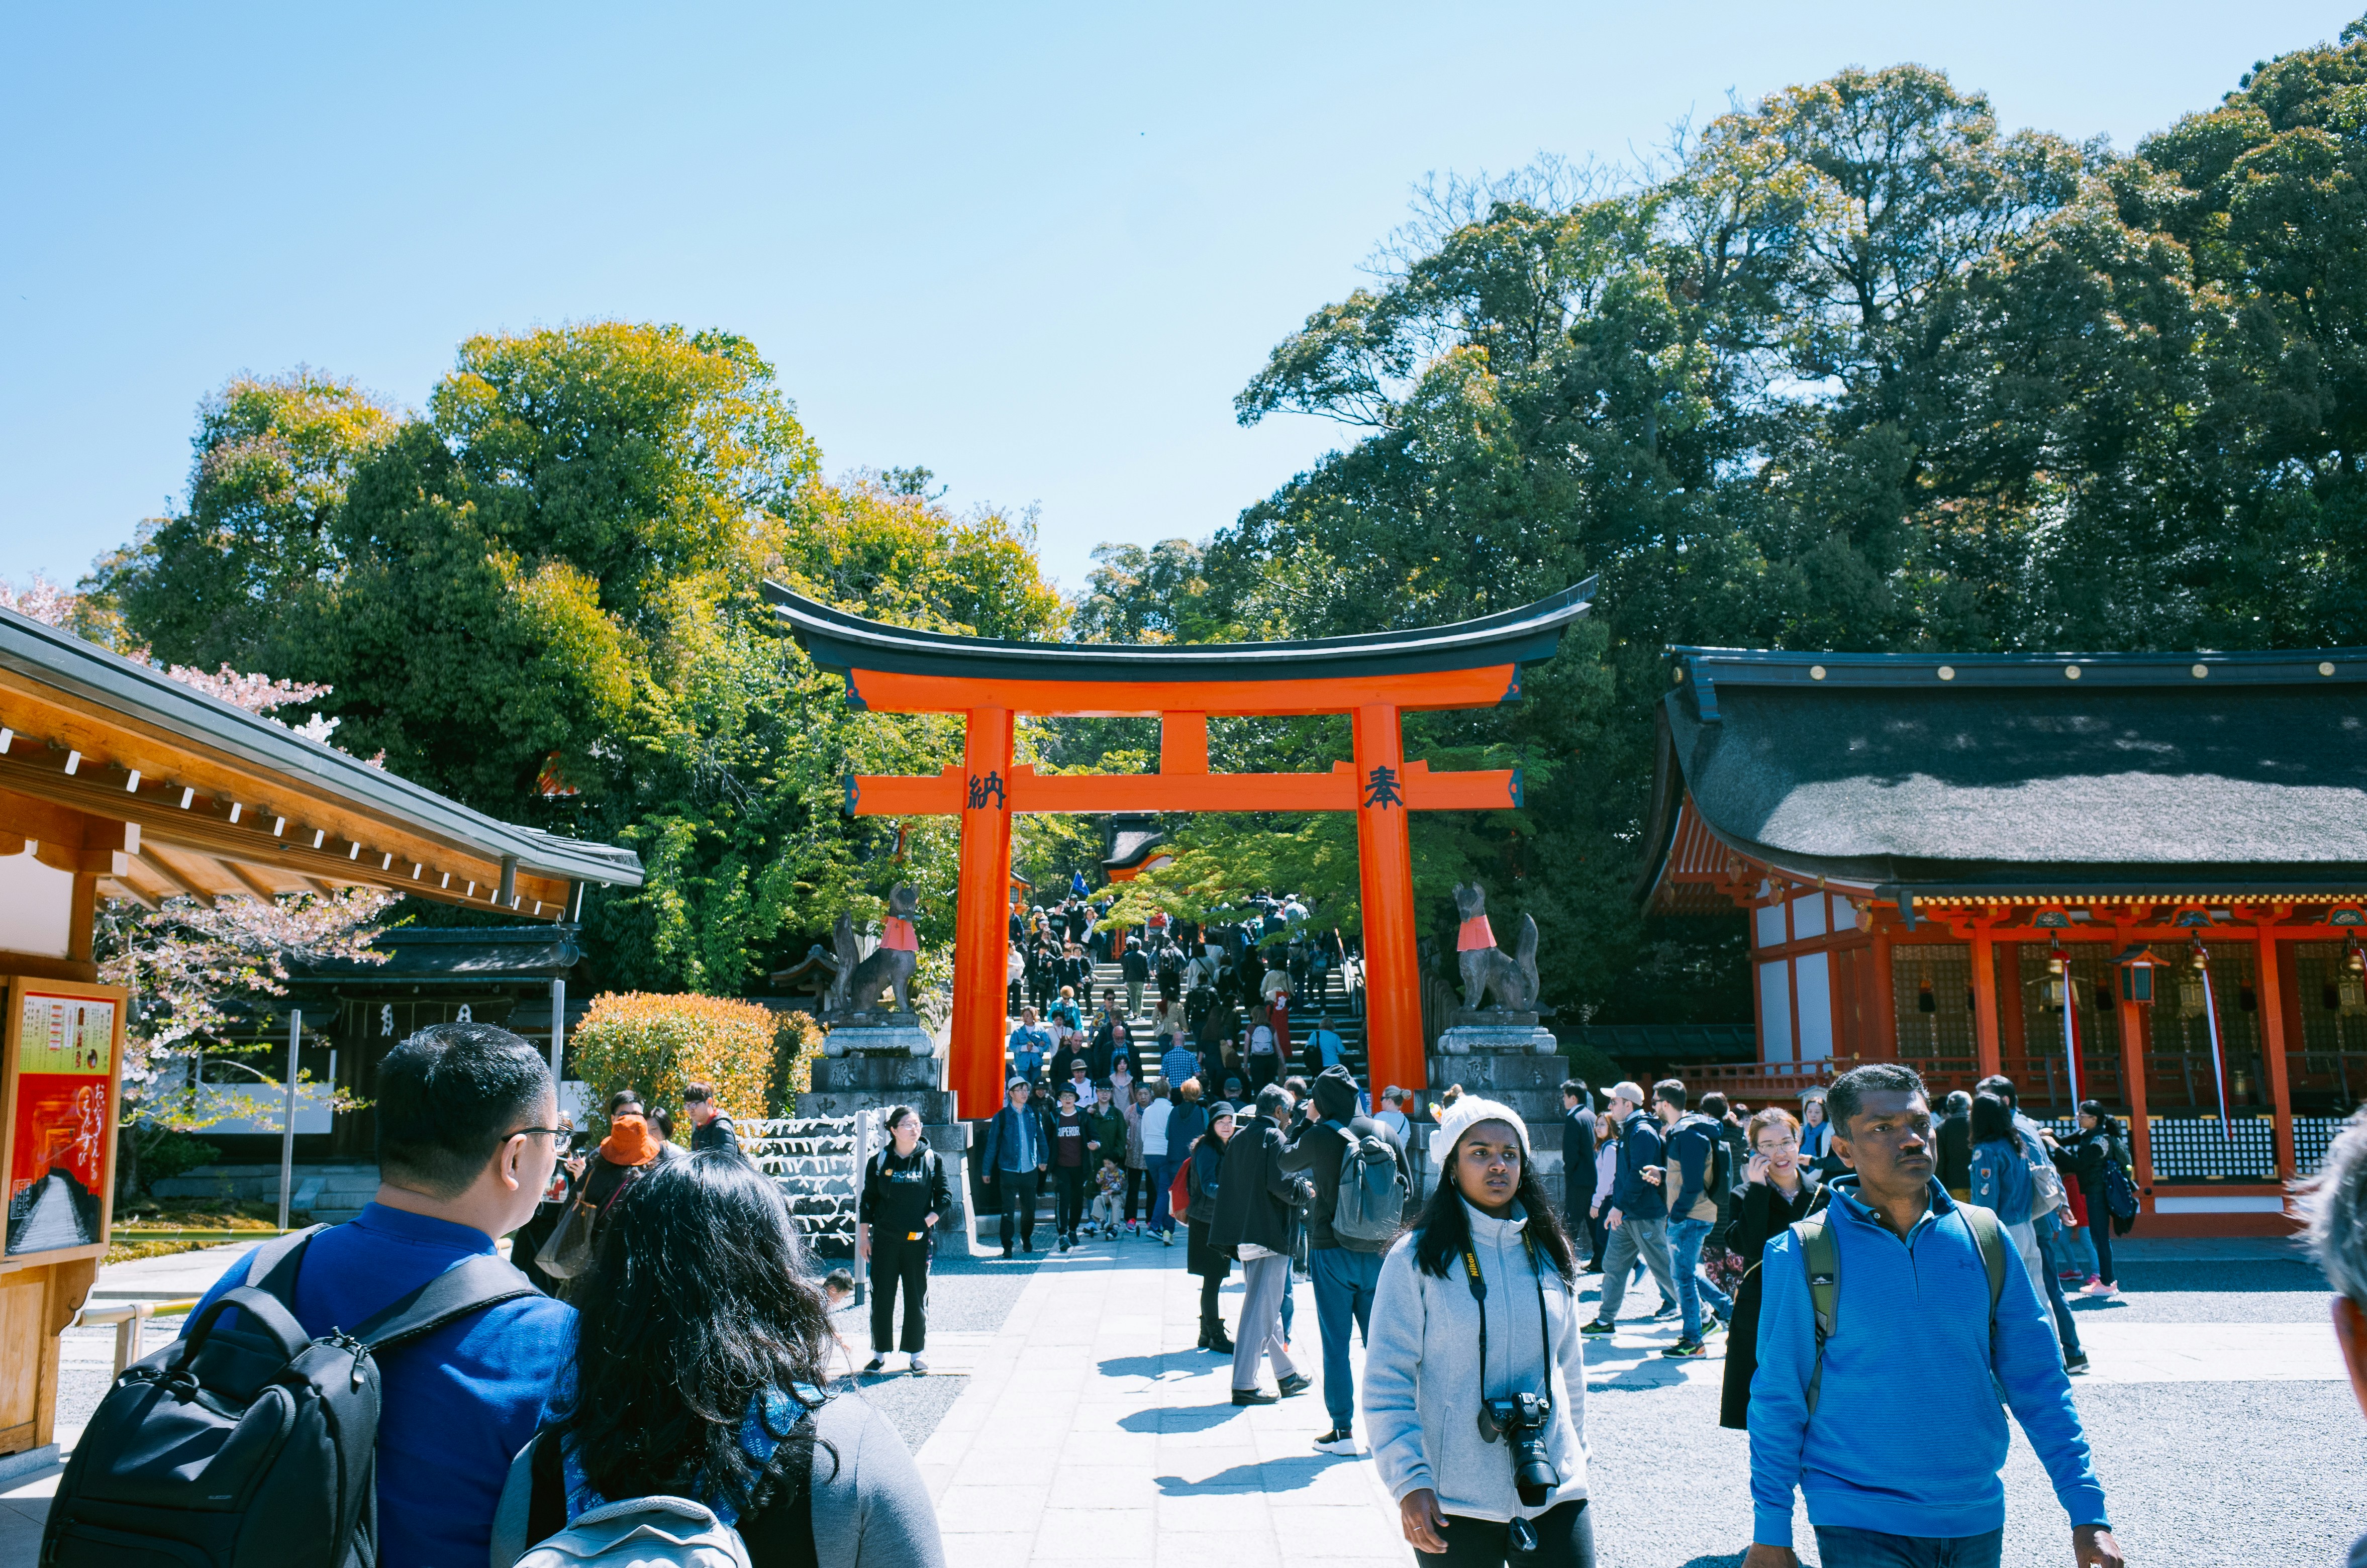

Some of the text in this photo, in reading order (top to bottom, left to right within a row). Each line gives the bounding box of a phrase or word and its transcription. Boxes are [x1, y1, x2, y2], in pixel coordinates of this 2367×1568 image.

[966, 770, 1006, 810] 納
[1364, 765, 1404, 811] 奉
[1057, 1126, 1080, 1137] SUPERDR
[1466, 1253, 1479, 1277] Nikon
[755, 1438, 764, 1457] cisco
